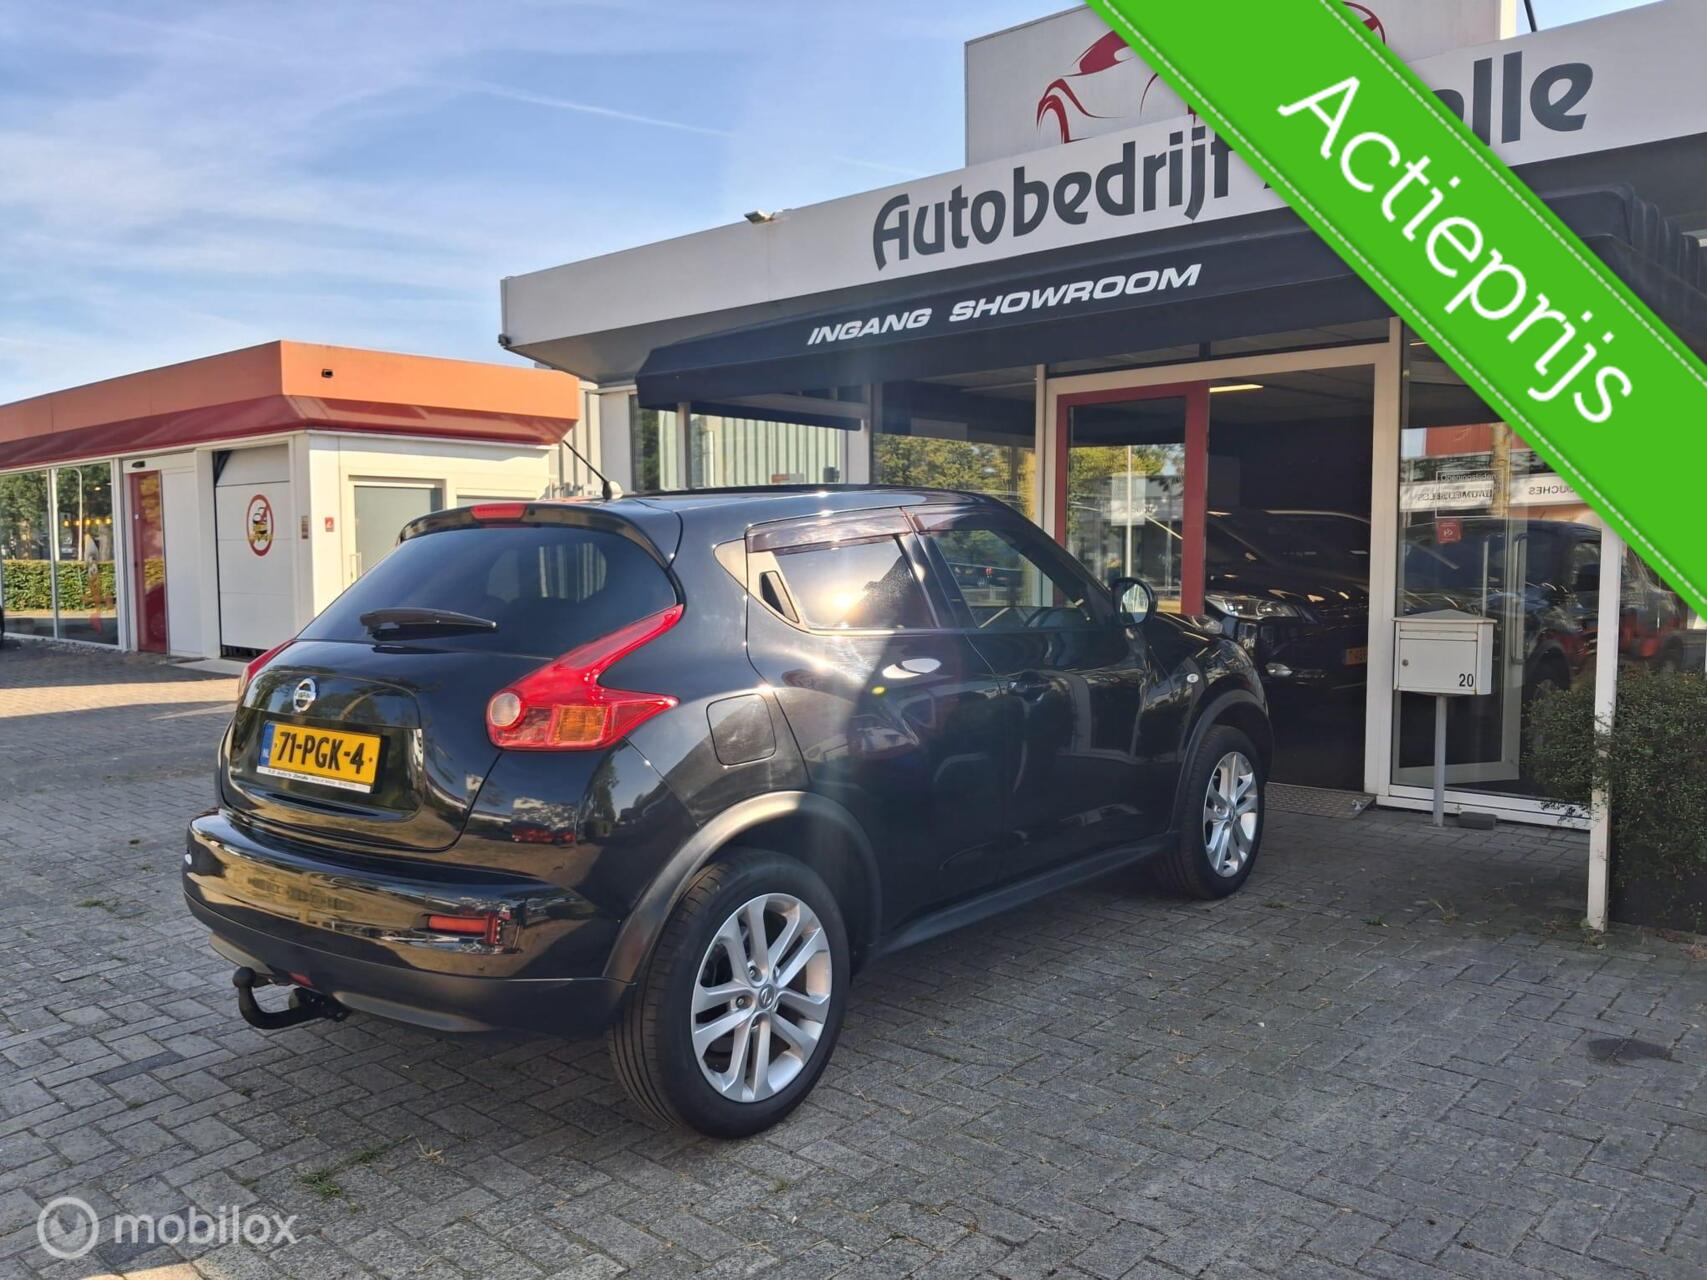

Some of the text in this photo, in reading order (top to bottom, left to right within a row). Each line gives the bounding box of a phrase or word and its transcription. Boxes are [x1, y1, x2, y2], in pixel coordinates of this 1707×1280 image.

[807, 264, 1201, 345] INGANG SHOWROOM
[1458, 673, 1474, 688] 20
[277, 731, 366, 775] 71-PGK-4
